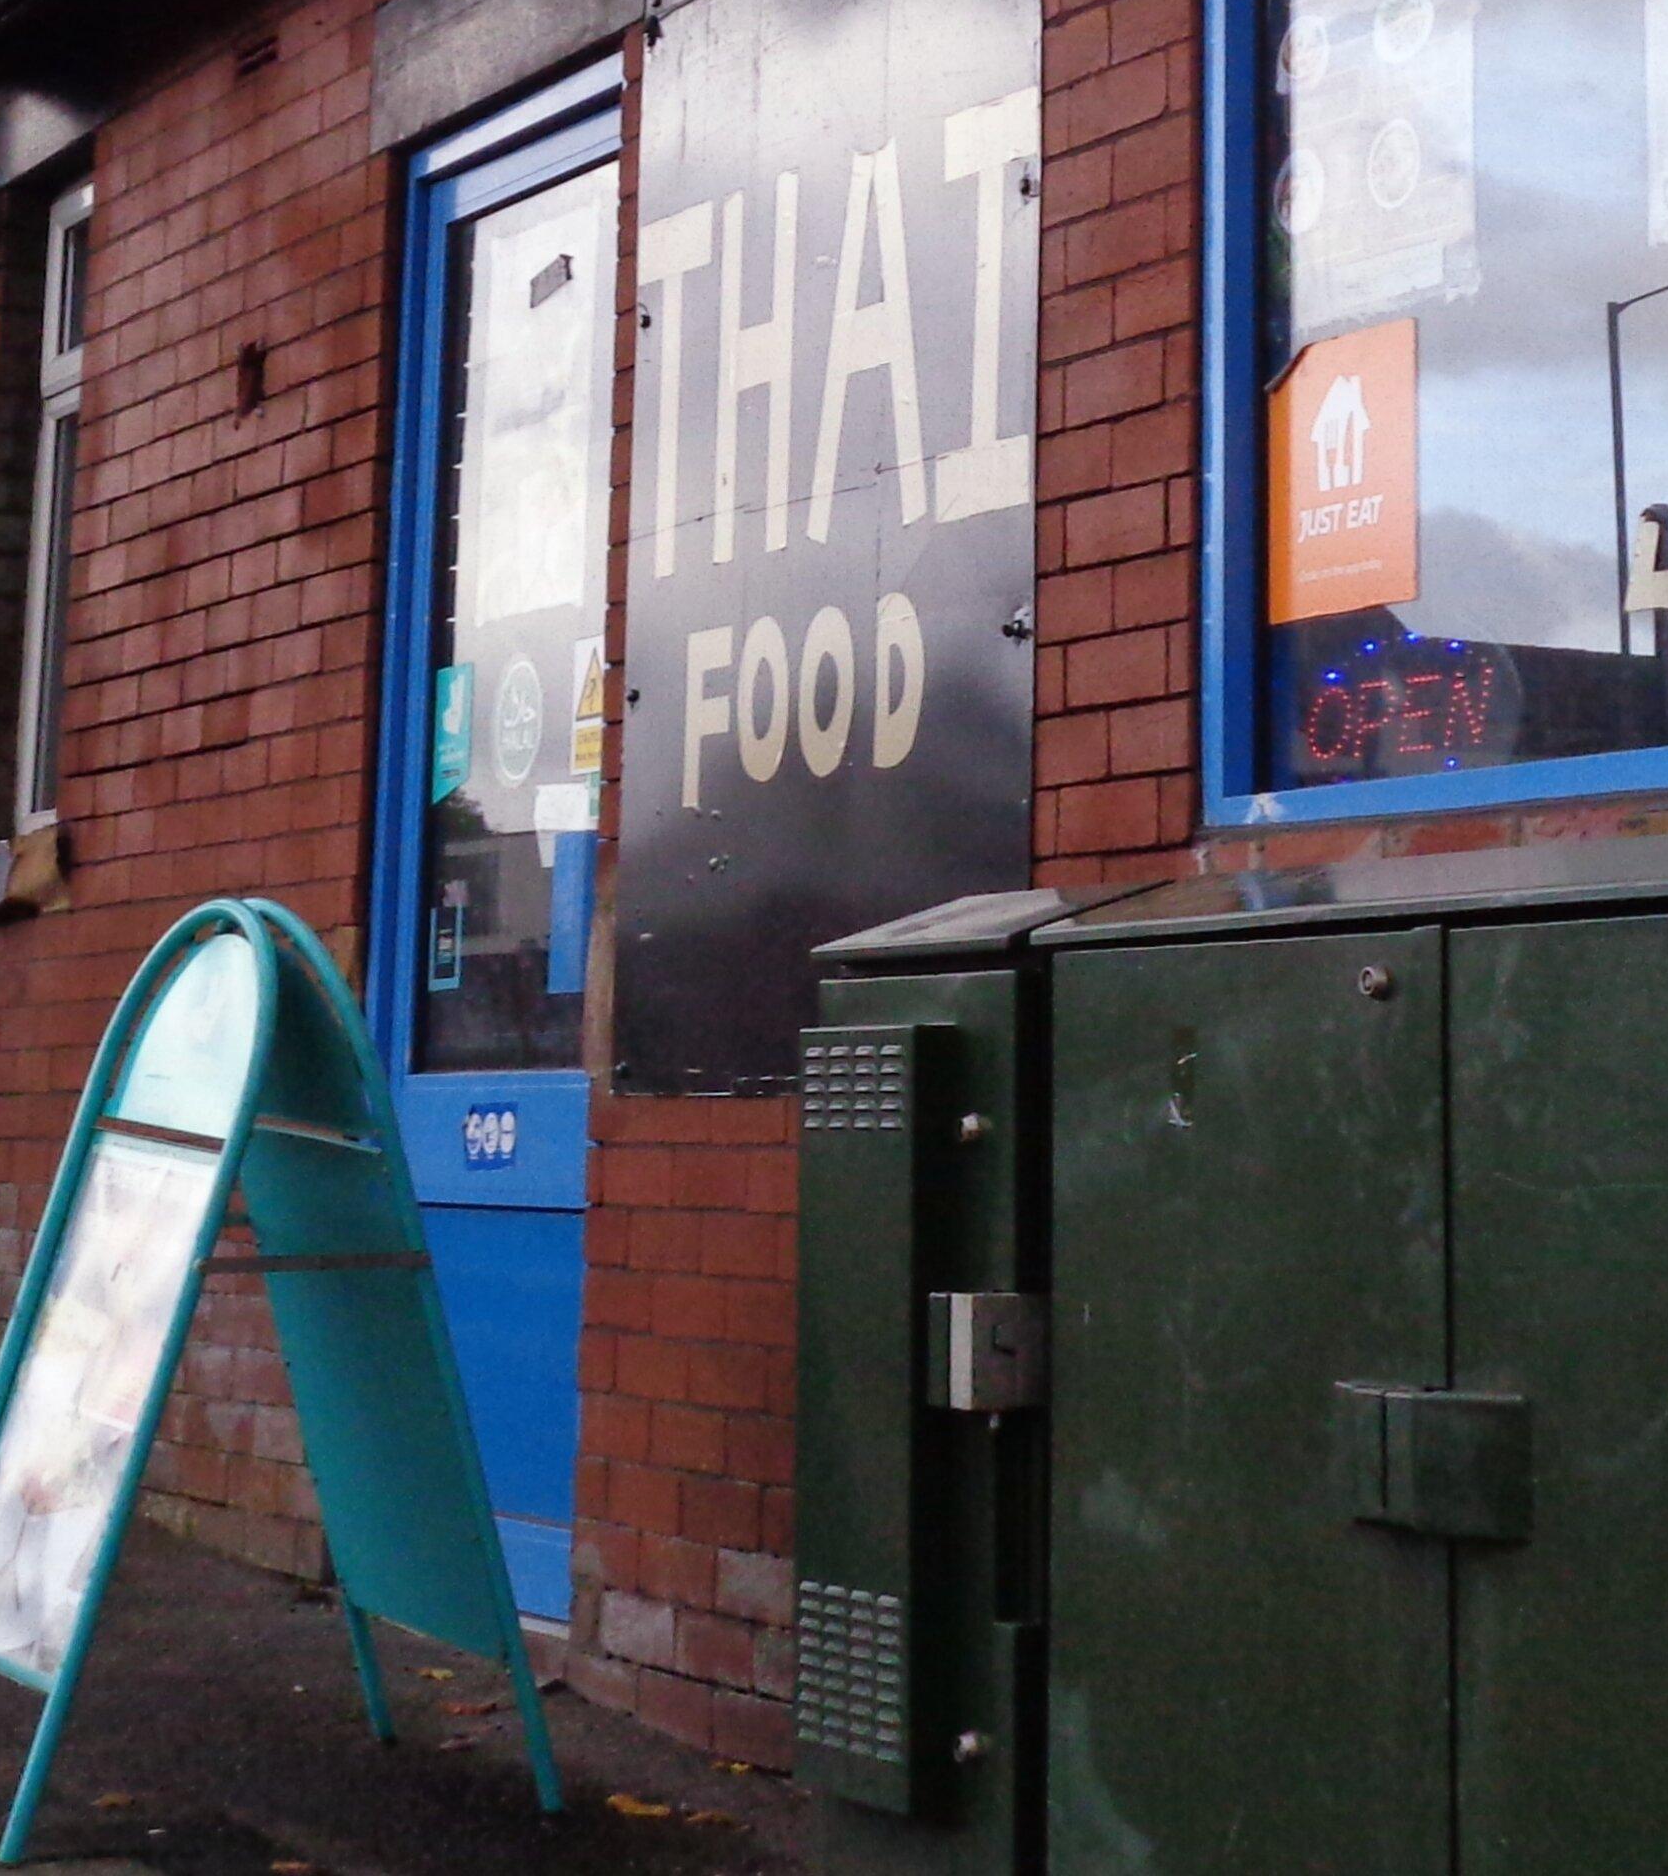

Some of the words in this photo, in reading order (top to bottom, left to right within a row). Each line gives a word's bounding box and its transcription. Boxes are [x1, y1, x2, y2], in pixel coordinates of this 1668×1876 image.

[636, 87, 1041, 580] THAI
[1297, 503, 1343, 544] JUST
[1347, 494, 1383, 529] EAT
[681, 591, 926, 810] FOOD
[1307, 659, 1493, 760] OPEN
